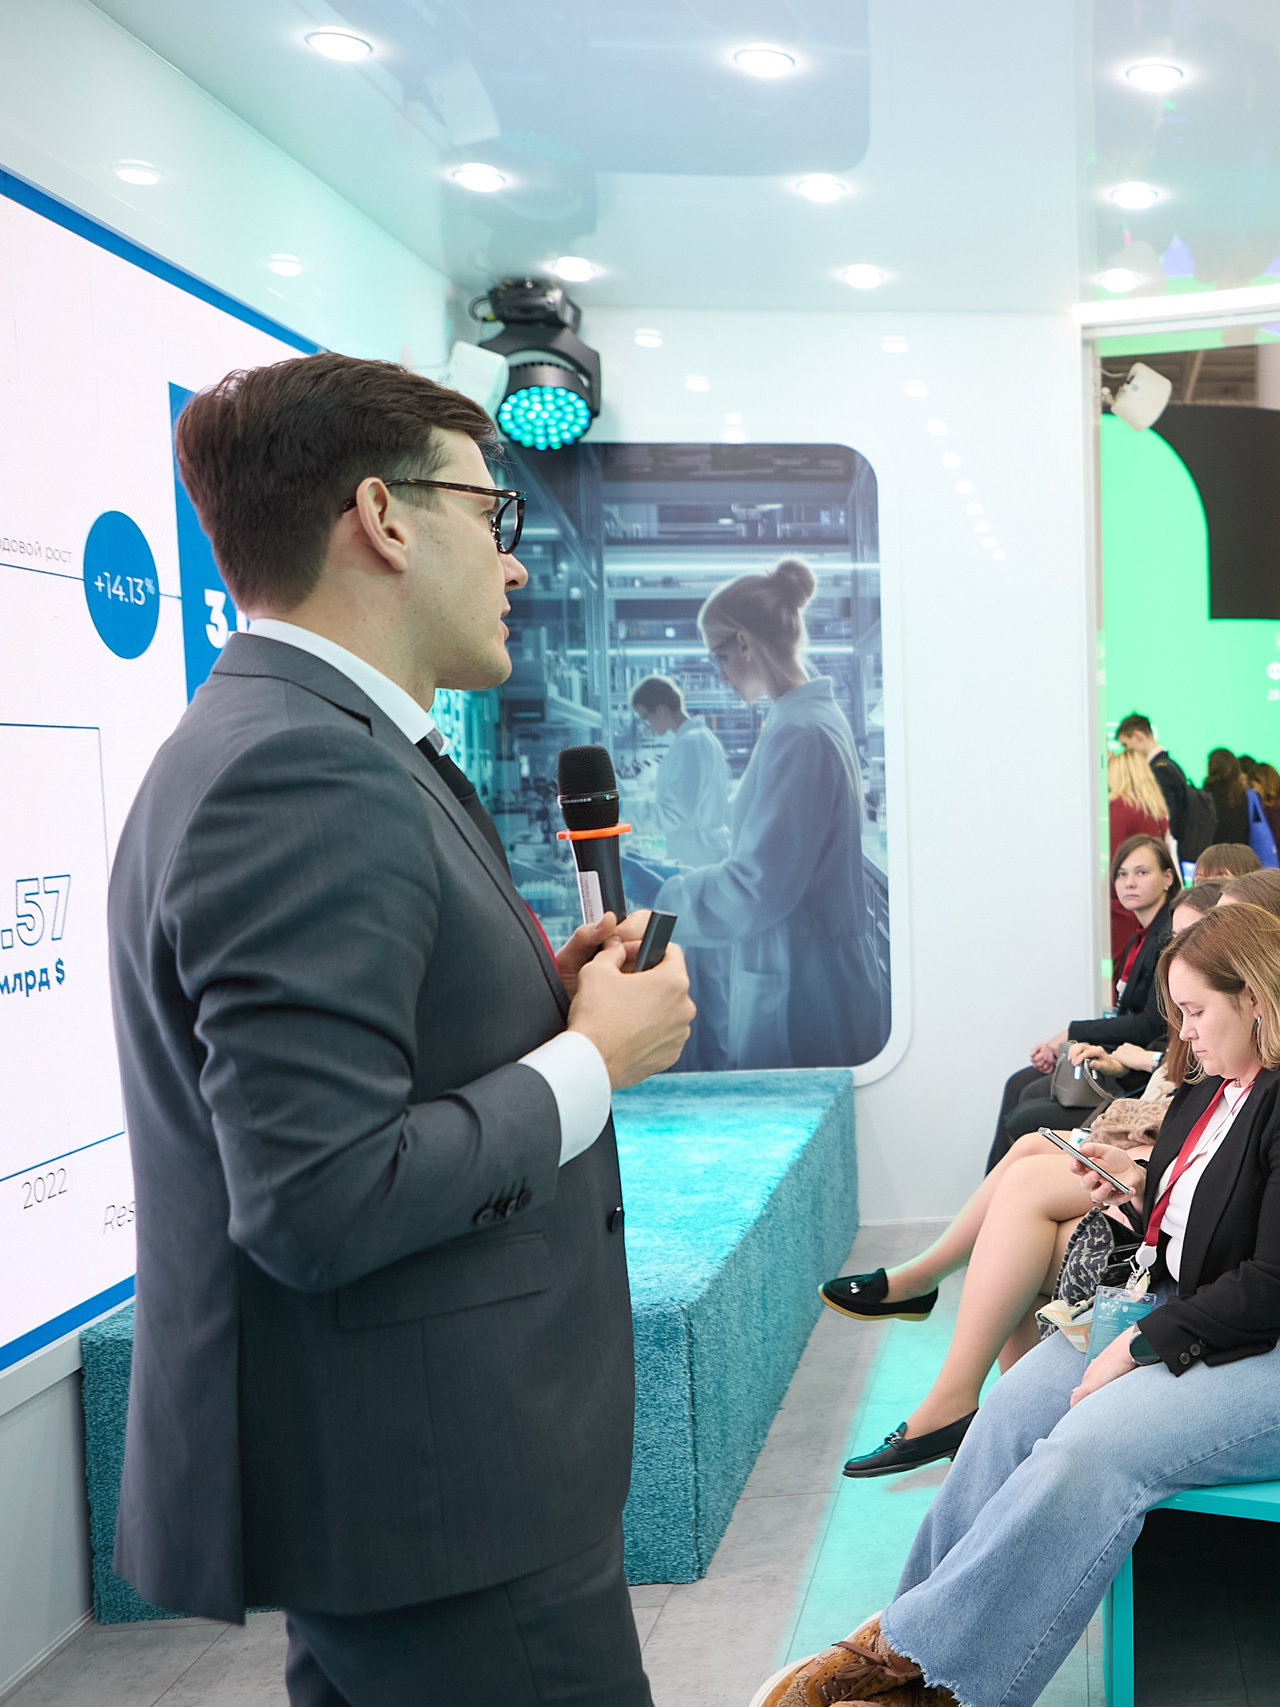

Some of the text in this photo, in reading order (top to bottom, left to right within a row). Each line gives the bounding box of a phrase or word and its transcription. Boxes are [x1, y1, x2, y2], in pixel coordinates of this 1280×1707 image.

[0, 537, 72, 563] довой рост
[55, 957, 66, 985] $
[22, 1168, 68, 1210] 2022
